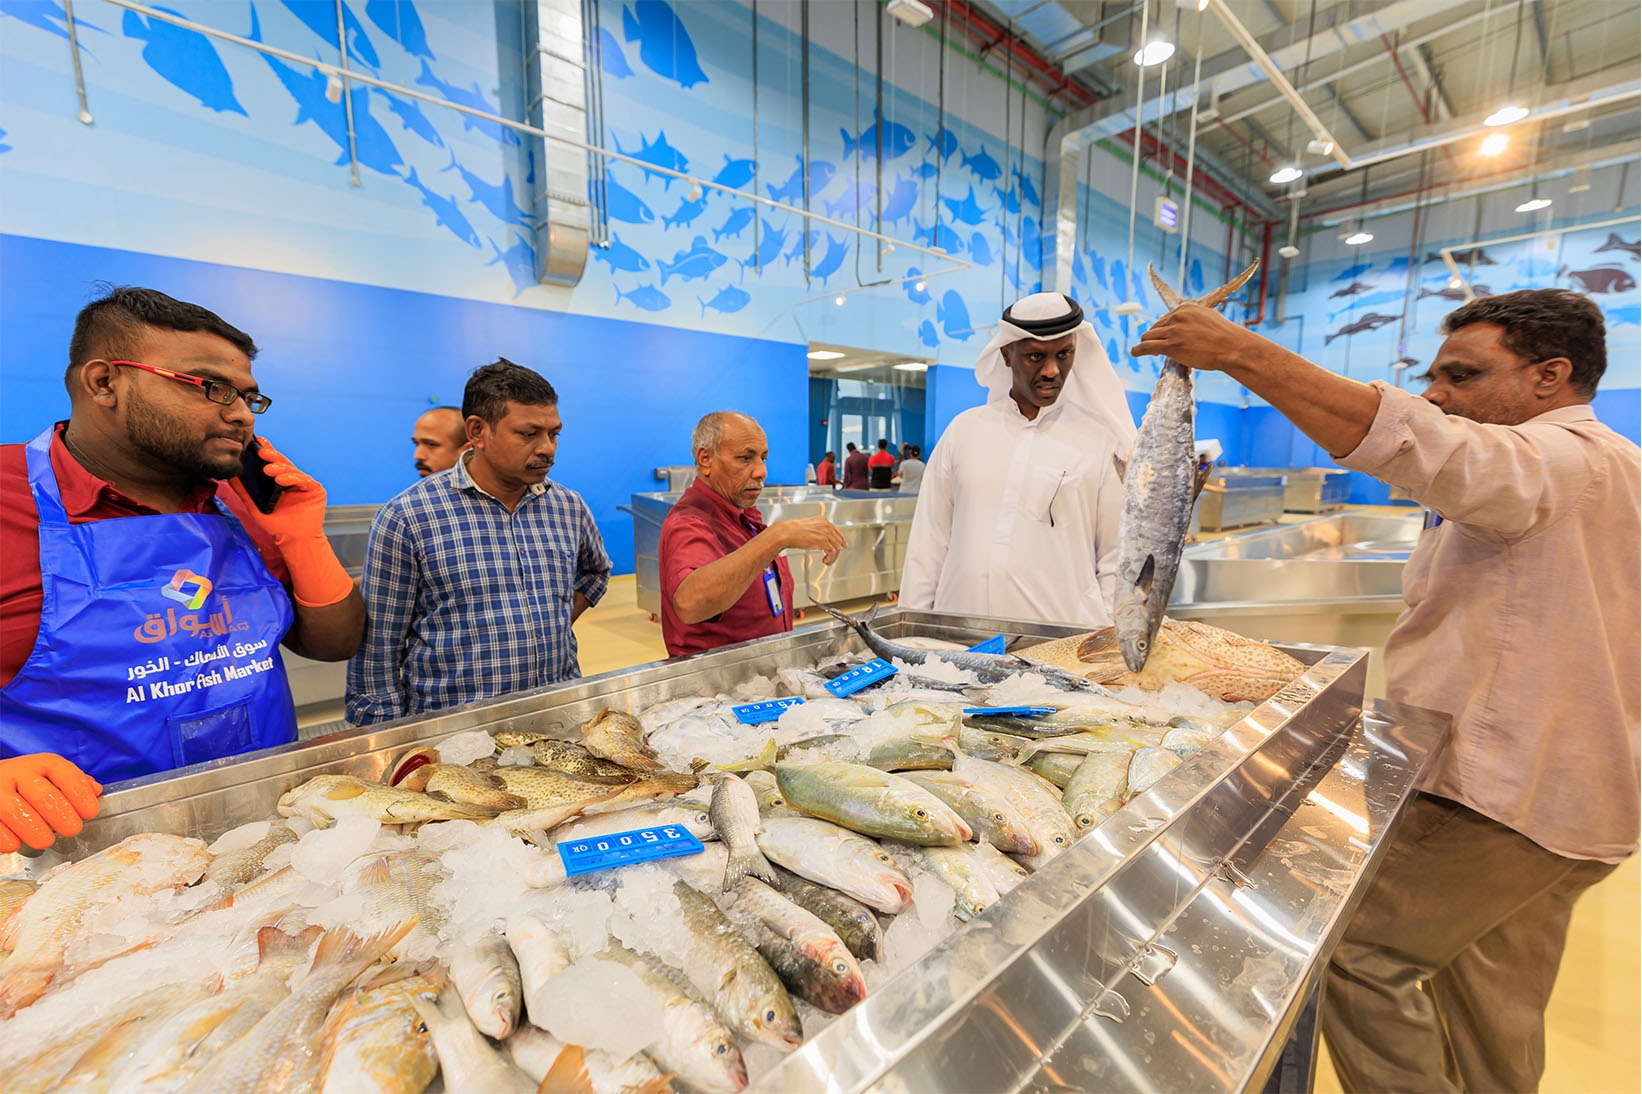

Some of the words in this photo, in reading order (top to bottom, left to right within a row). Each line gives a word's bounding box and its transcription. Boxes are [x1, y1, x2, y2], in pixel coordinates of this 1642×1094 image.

[133, 595, 233, 644] أسواق
[232, 639, 268, 659] سوق
[126, 686, 146, 703] Al
[150, 679, 195, 700] Khor
[223, 657, 274, 682] Market
[127, 656, 170, 681] الخور
[572, 845, 588, 853] QR
